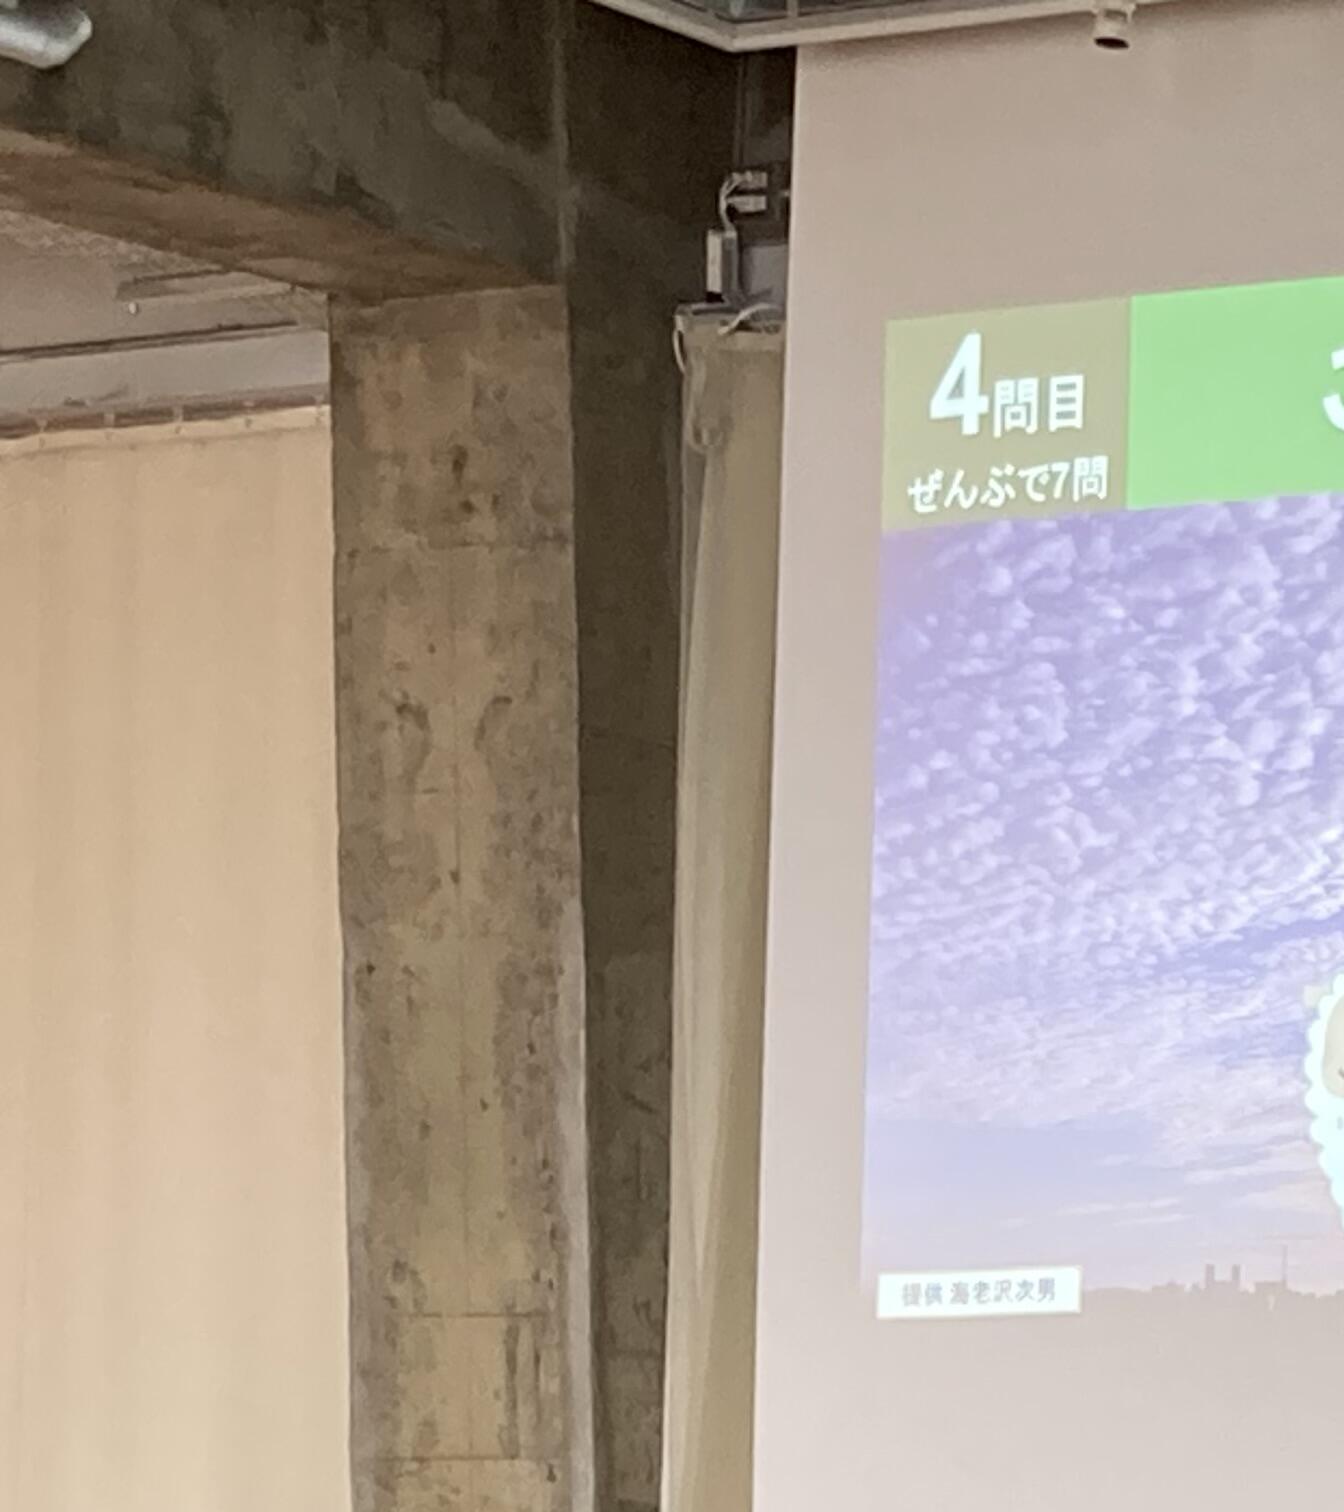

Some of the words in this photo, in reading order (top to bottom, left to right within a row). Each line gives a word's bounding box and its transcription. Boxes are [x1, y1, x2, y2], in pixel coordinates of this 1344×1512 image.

[929, 331, 1085, 438] 4問目
[906, 454, 1109, 515] ぜんぶで7問
